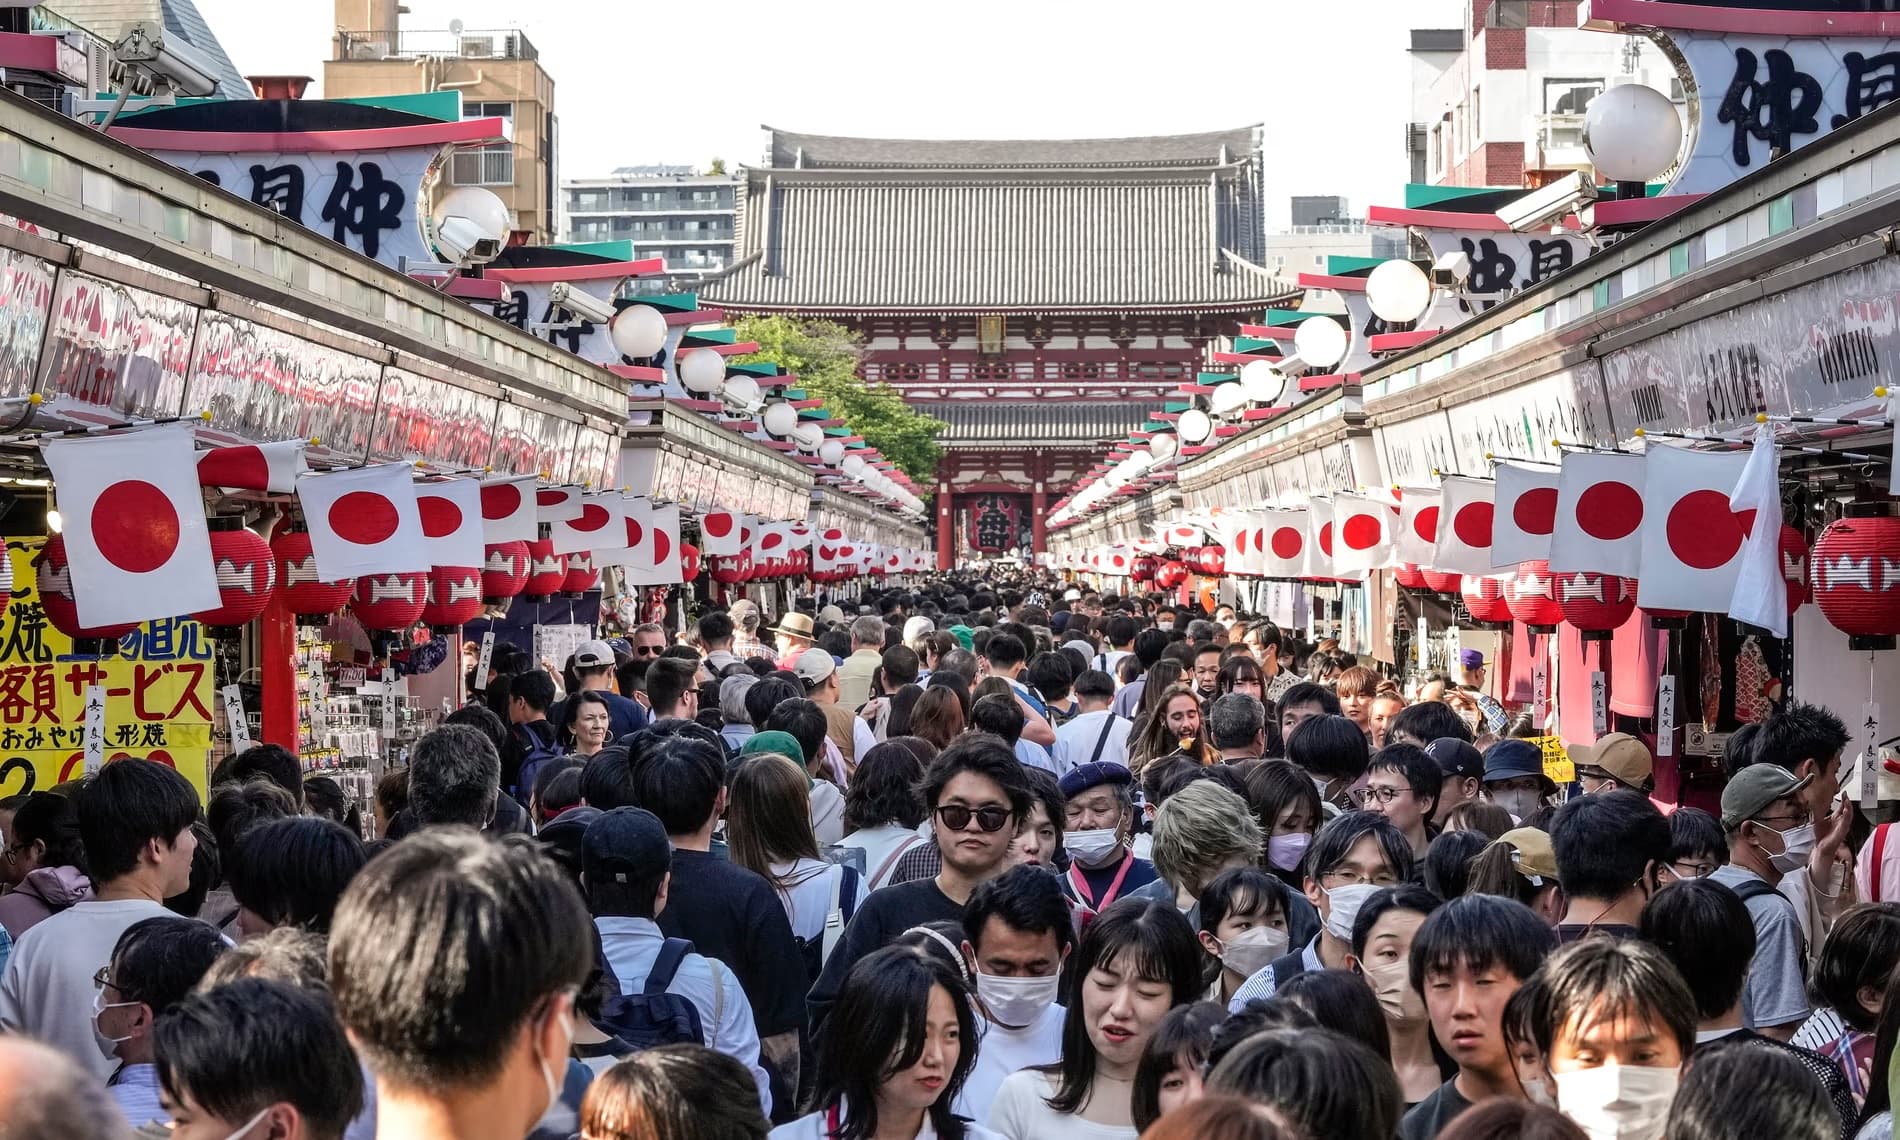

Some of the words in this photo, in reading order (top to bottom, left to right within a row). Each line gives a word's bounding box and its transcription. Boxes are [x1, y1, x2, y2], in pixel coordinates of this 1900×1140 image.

[1816, 326, 1879, 385] COSMETICS
[976, 495, 1011, 549] 小舟町
[0, 602, 48, 663] 焼
[2, 724, 166, 749] おみやげ形焼
